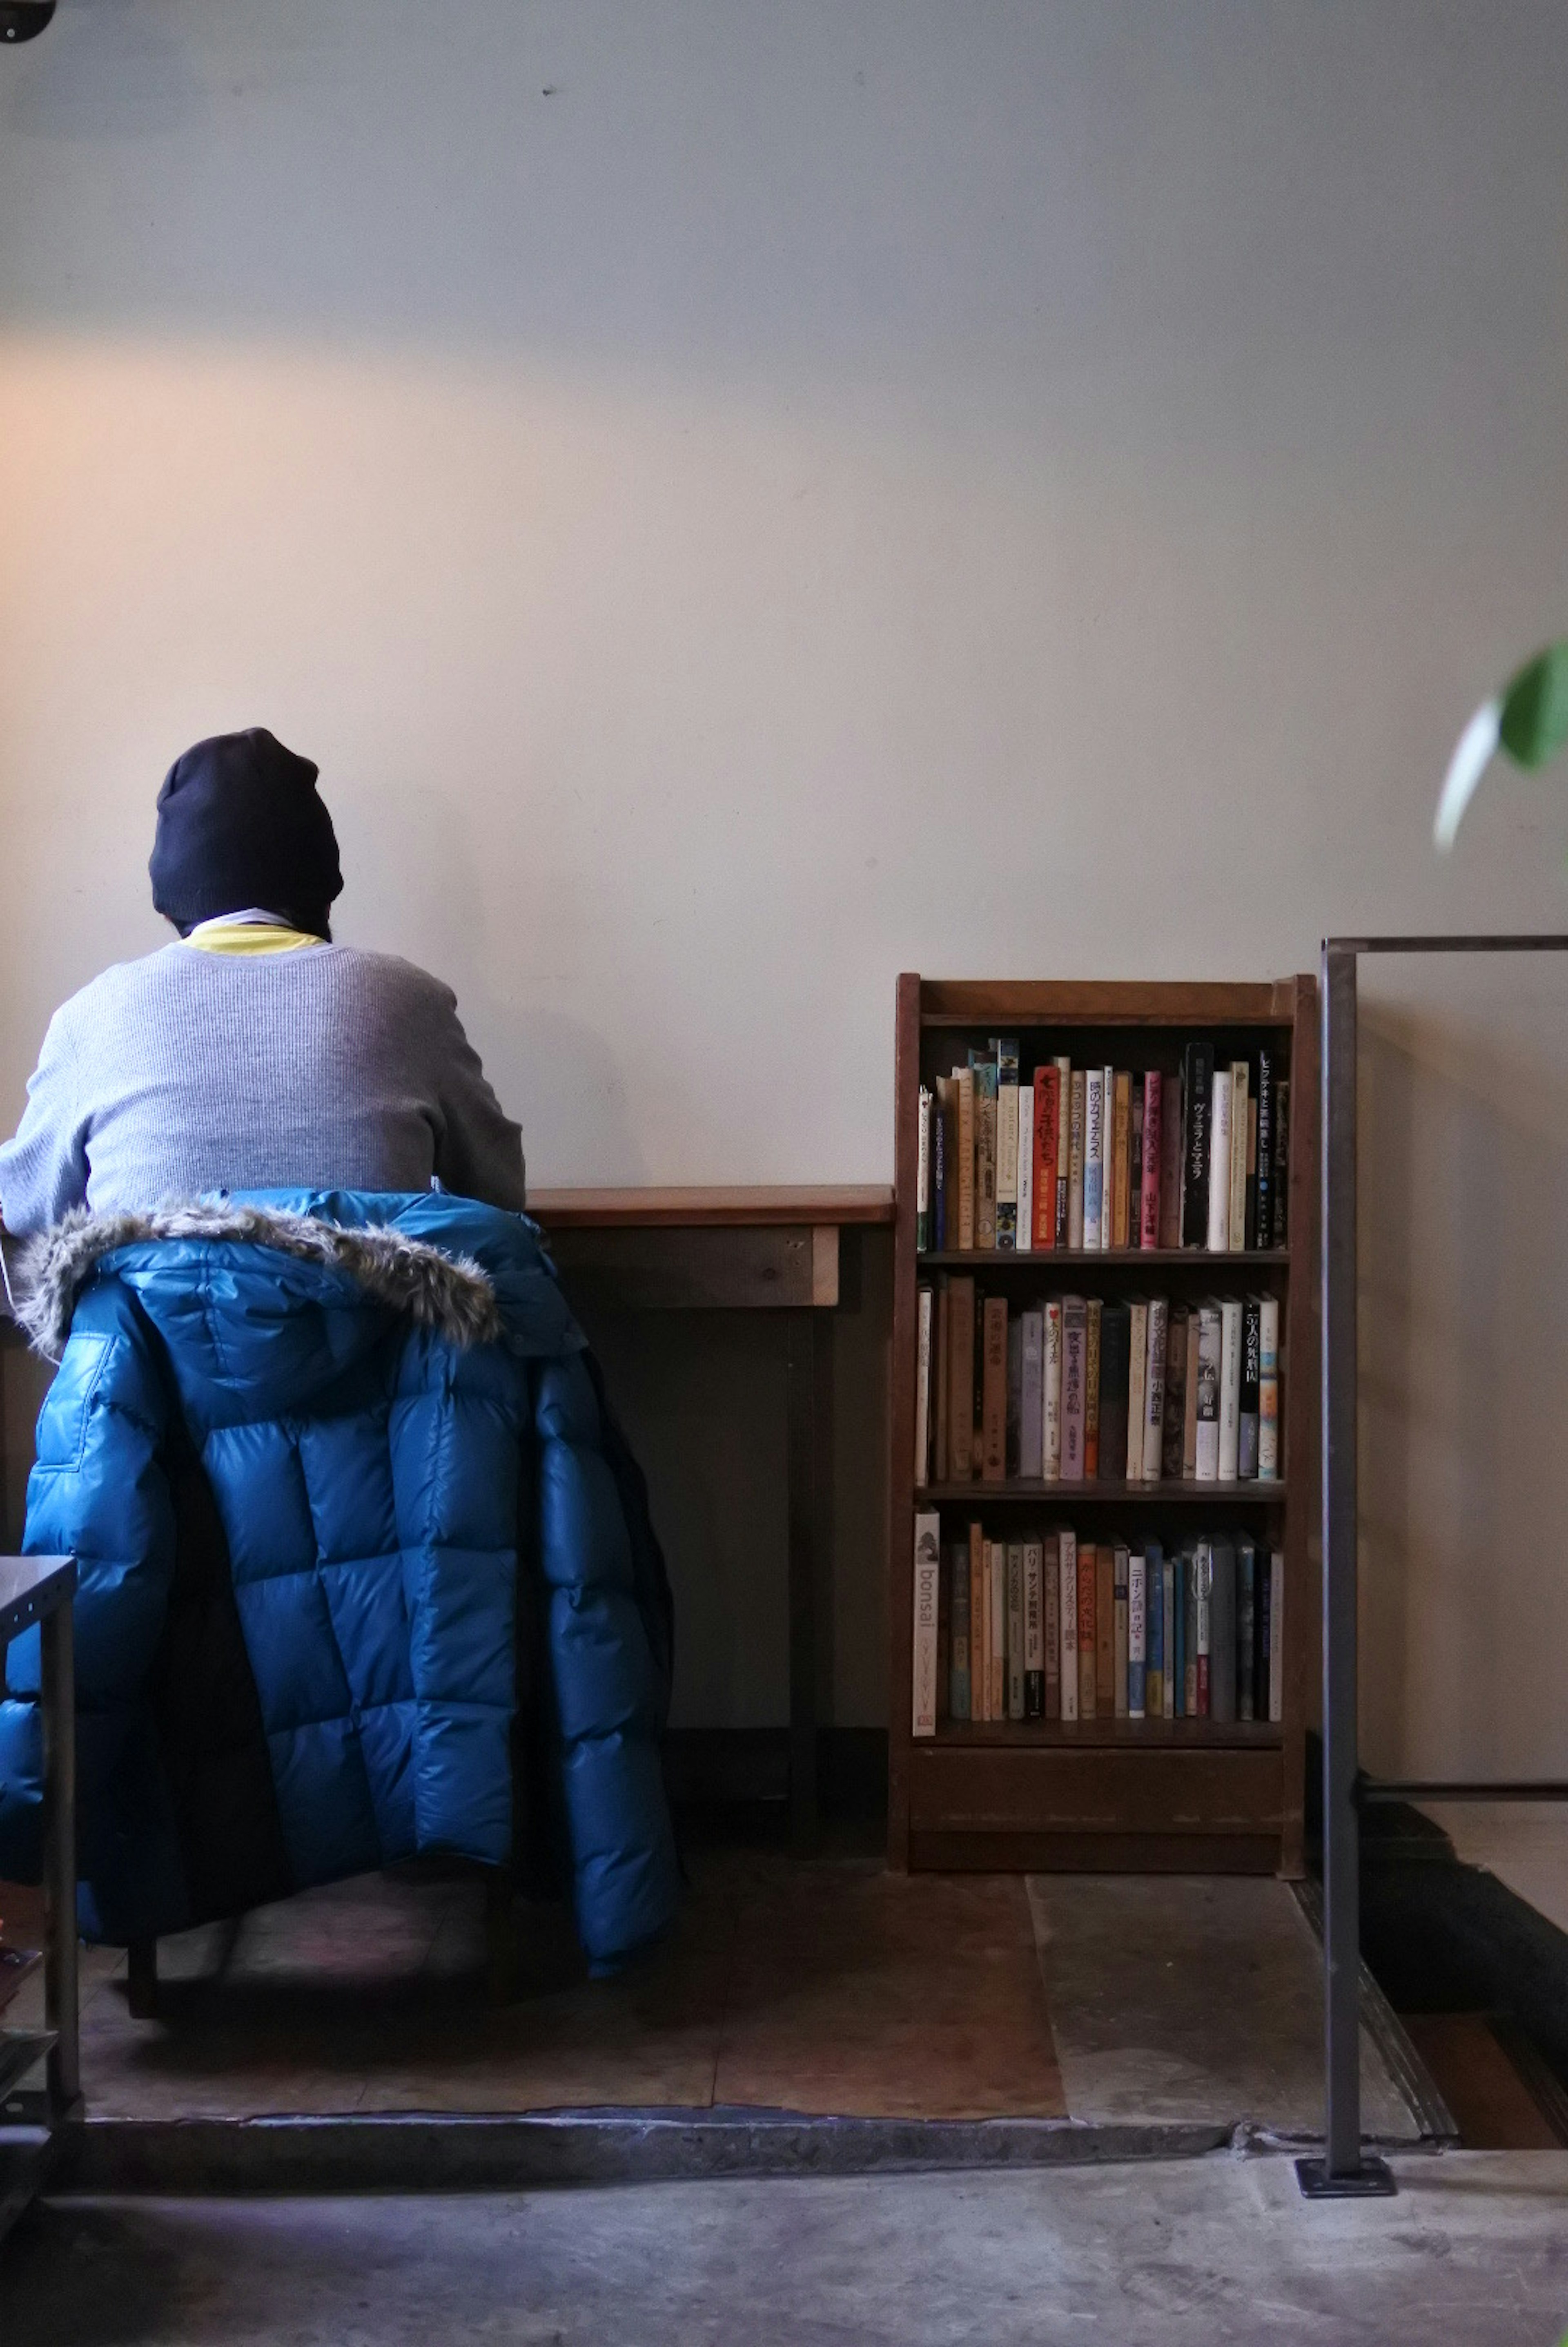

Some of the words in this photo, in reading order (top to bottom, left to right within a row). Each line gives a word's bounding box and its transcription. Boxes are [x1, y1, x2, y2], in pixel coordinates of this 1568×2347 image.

[1192, 1103, 1206, 1180] ヴァニラとマニラ
[1247, 1313, 1258, 1383] 57人の死刑囚
[920, 1570, 935, 1628] bonsai
[1131, 1570, 1143, 1633] ニホン語日記
